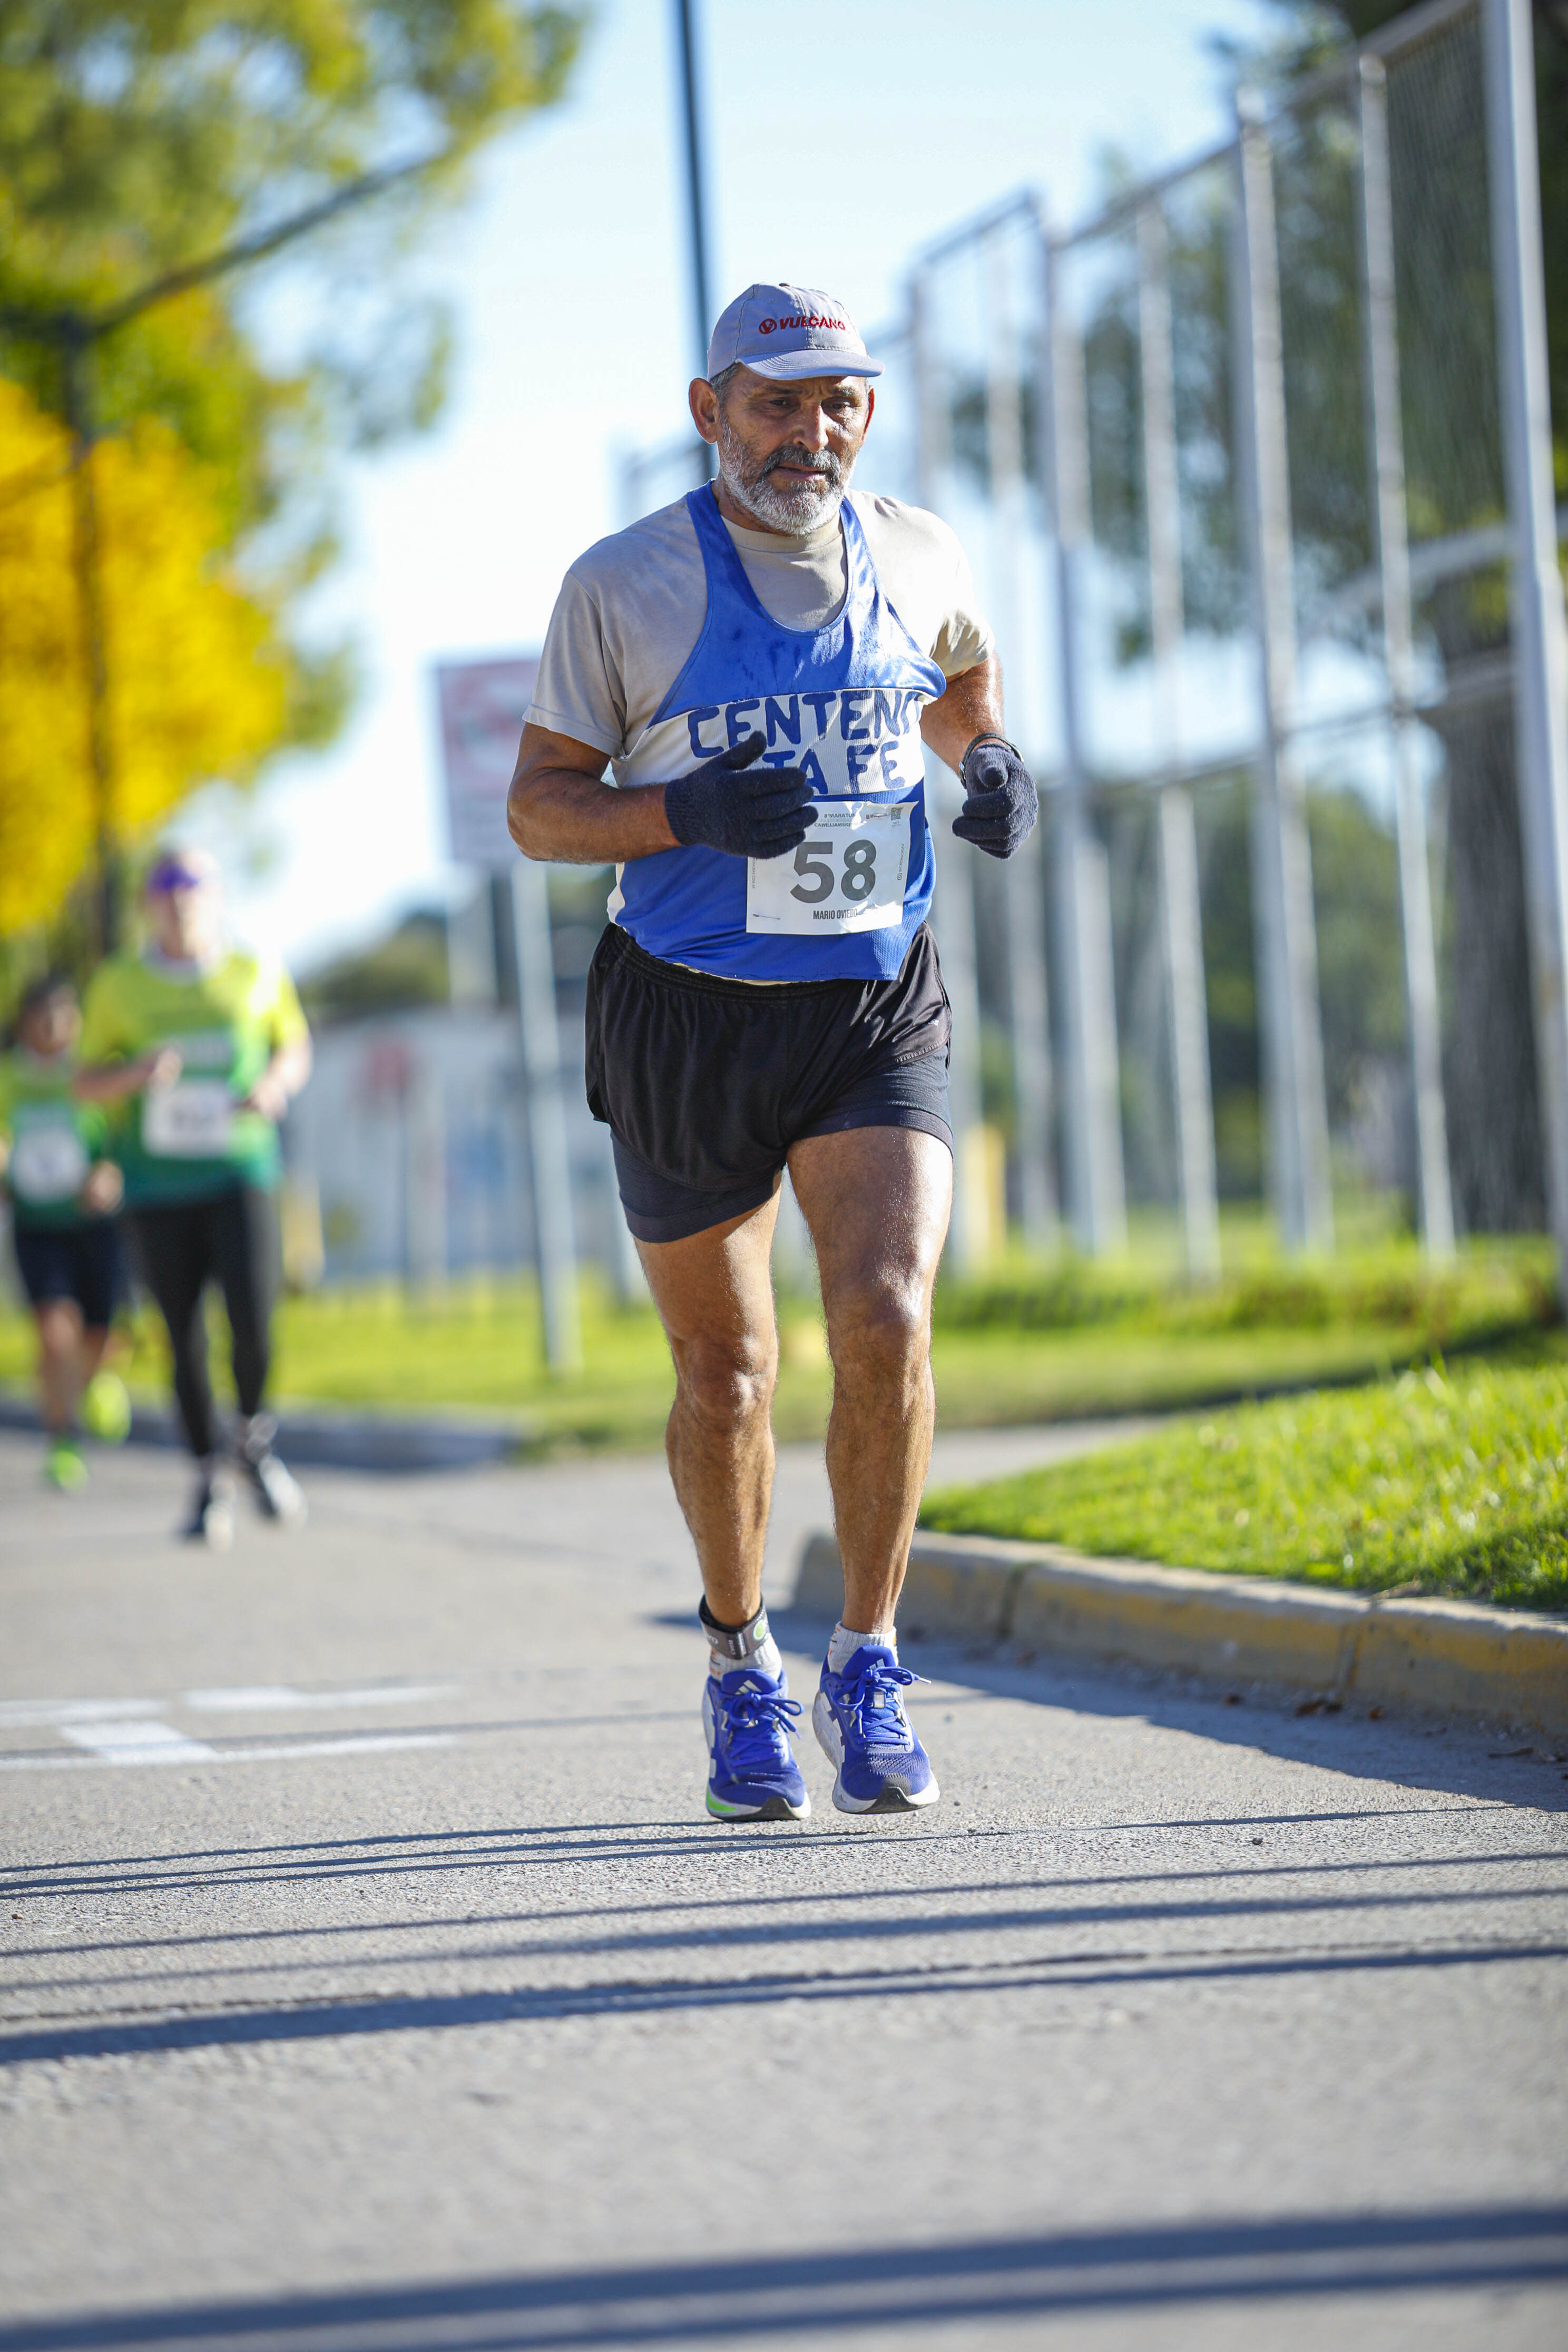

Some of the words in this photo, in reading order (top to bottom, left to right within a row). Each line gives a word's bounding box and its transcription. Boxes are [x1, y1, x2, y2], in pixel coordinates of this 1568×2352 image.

[780, 316, 846, 330] VULCANO
[846, 741, 905, 793] FE
[790, 839, 877, 904] 58
[813, 910, 835, 919] MARIO
[836, 908, 857, 919] OVIEDO
